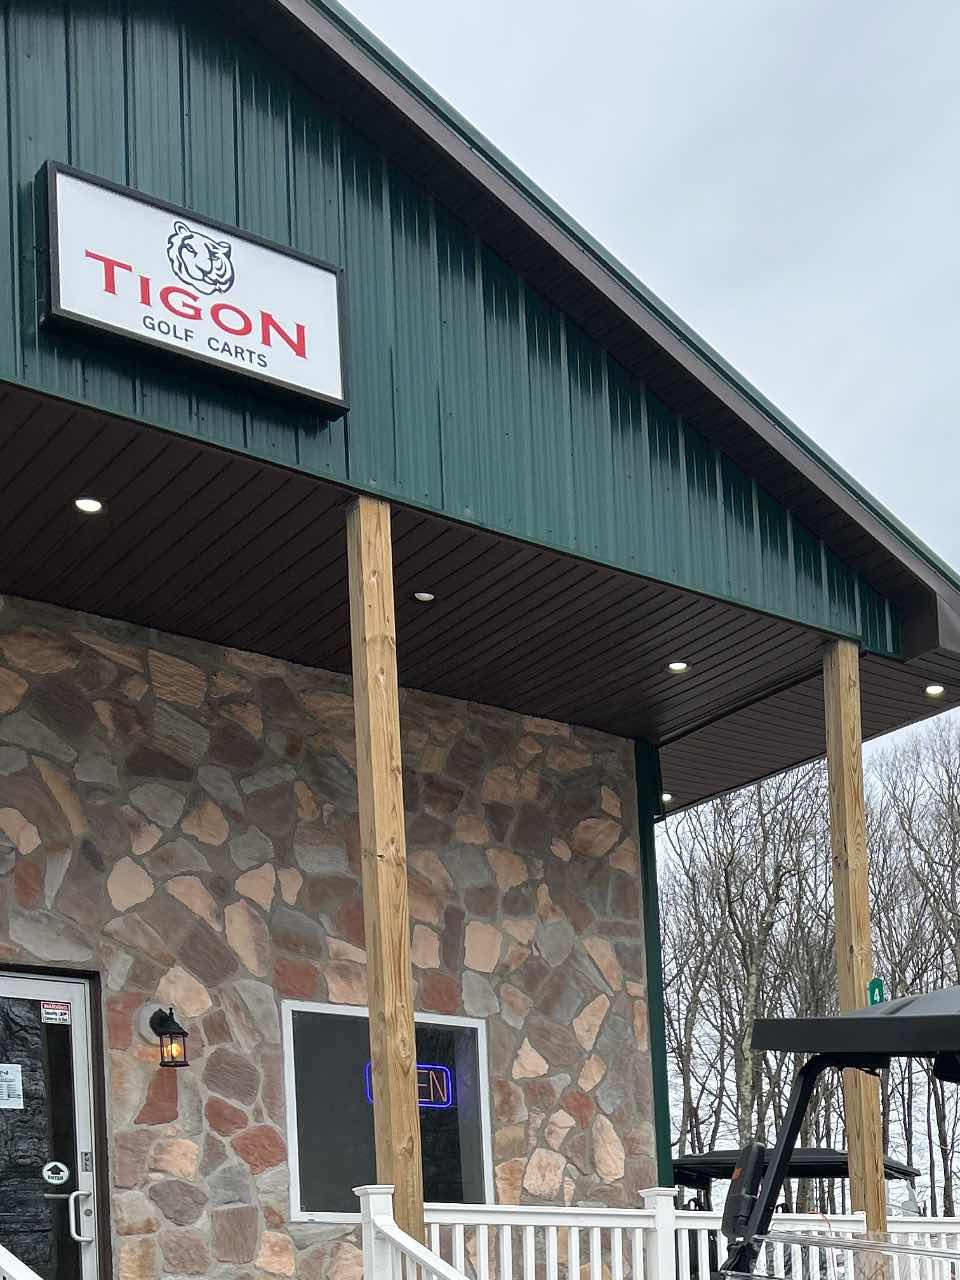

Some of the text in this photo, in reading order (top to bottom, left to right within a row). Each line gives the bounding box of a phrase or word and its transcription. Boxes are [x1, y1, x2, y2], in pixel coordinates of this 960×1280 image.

[84, 249, 308, 359] TIGON
[142, 315, 268, 368] GOLF CARTS
